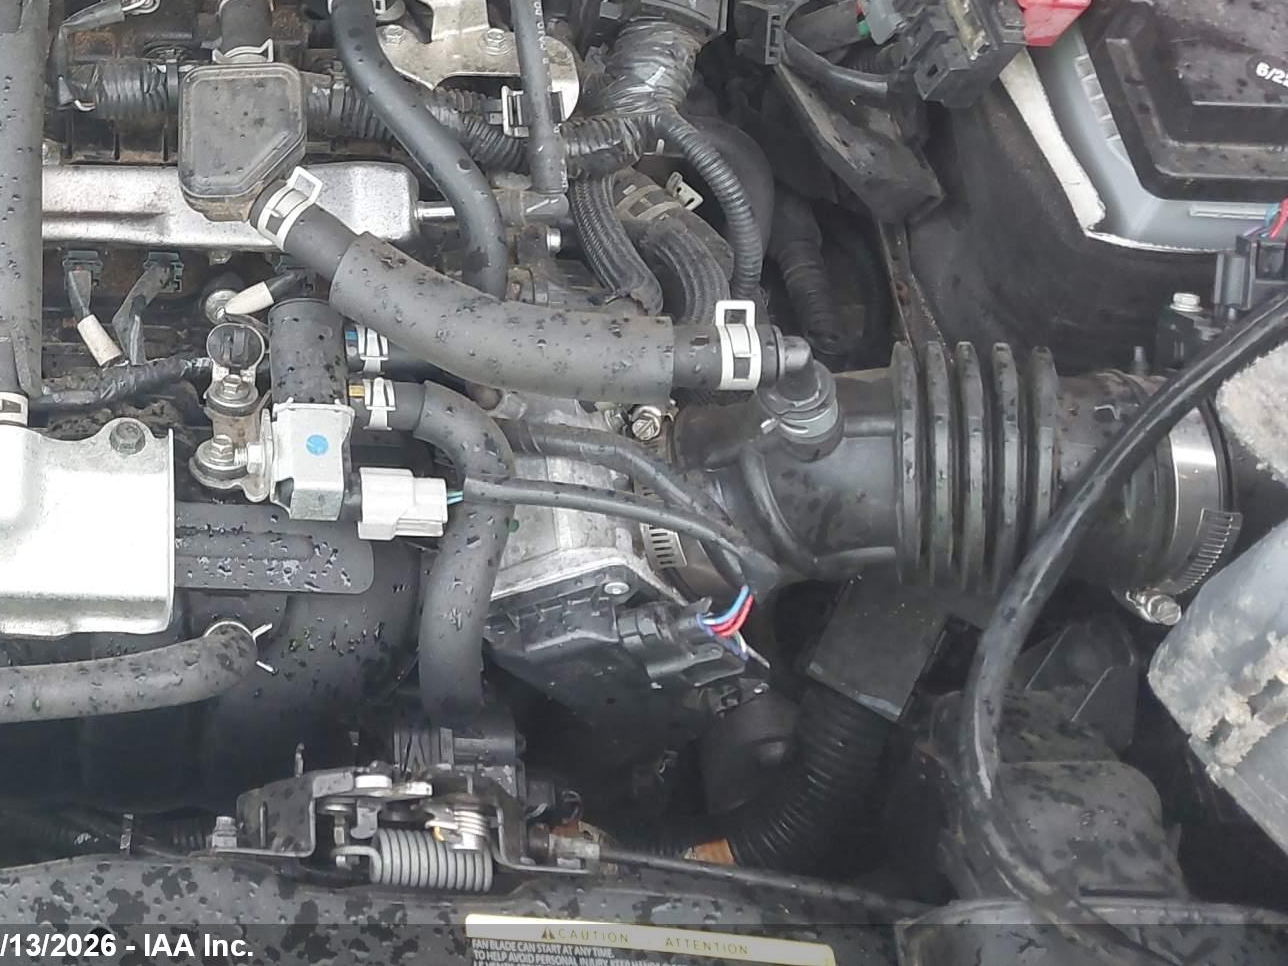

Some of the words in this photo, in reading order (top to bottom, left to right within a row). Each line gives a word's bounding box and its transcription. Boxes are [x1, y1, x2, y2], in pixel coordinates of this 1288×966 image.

[558, 928, 629, 943] CAUTION
[472, 938, 489, 949] FAN
[489, 939, 516, 951] BLADE
[517, 941, 536, 953] CAN
[536, 943, 561, 954] START
[562, 945, 573, 955] AT
[574, 946, 592, 956] ANY
[665, 937, 748, 955] ATTENTION
[473, 949, 486, 960] TO
[487, 951, 508, 962] HELP
[508, 952, 535, 964] AVOID
[535, 954, 578, 966] PERSONAL
